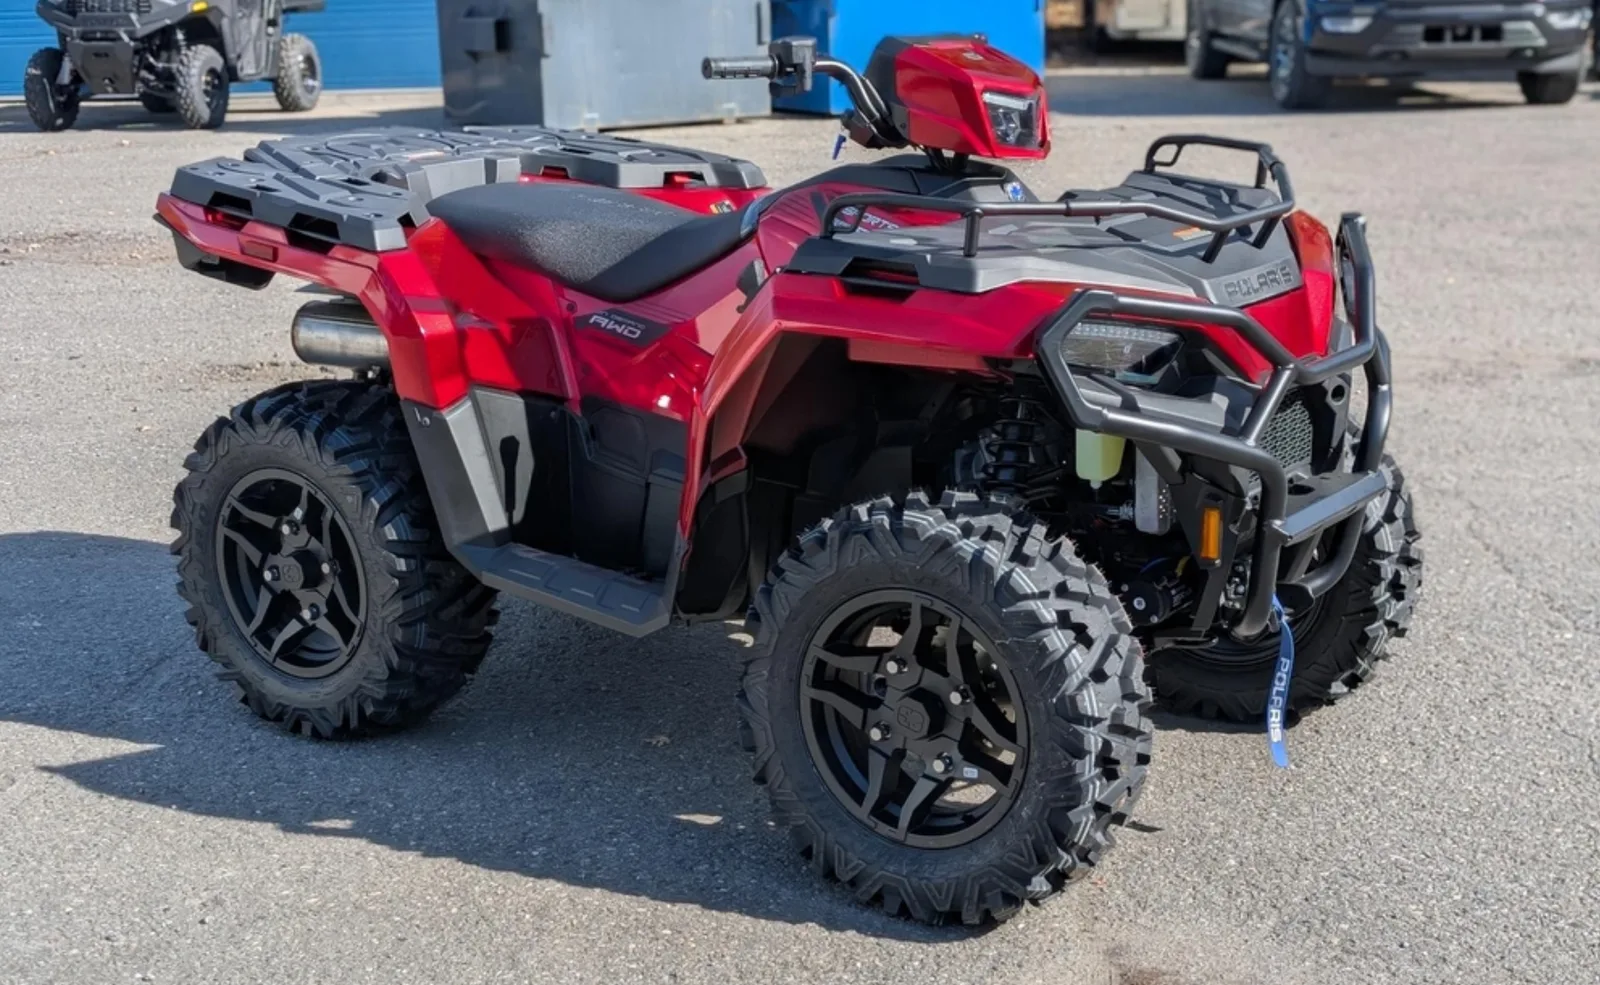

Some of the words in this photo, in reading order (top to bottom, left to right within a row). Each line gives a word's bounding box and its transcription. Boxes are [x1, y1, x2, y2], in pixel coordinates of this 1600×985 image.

[1223, 265, 1293, 300] POLARIS
[589, 315, 641, 339] AWD
[1268, 657, 1290, 743] POLARIS
